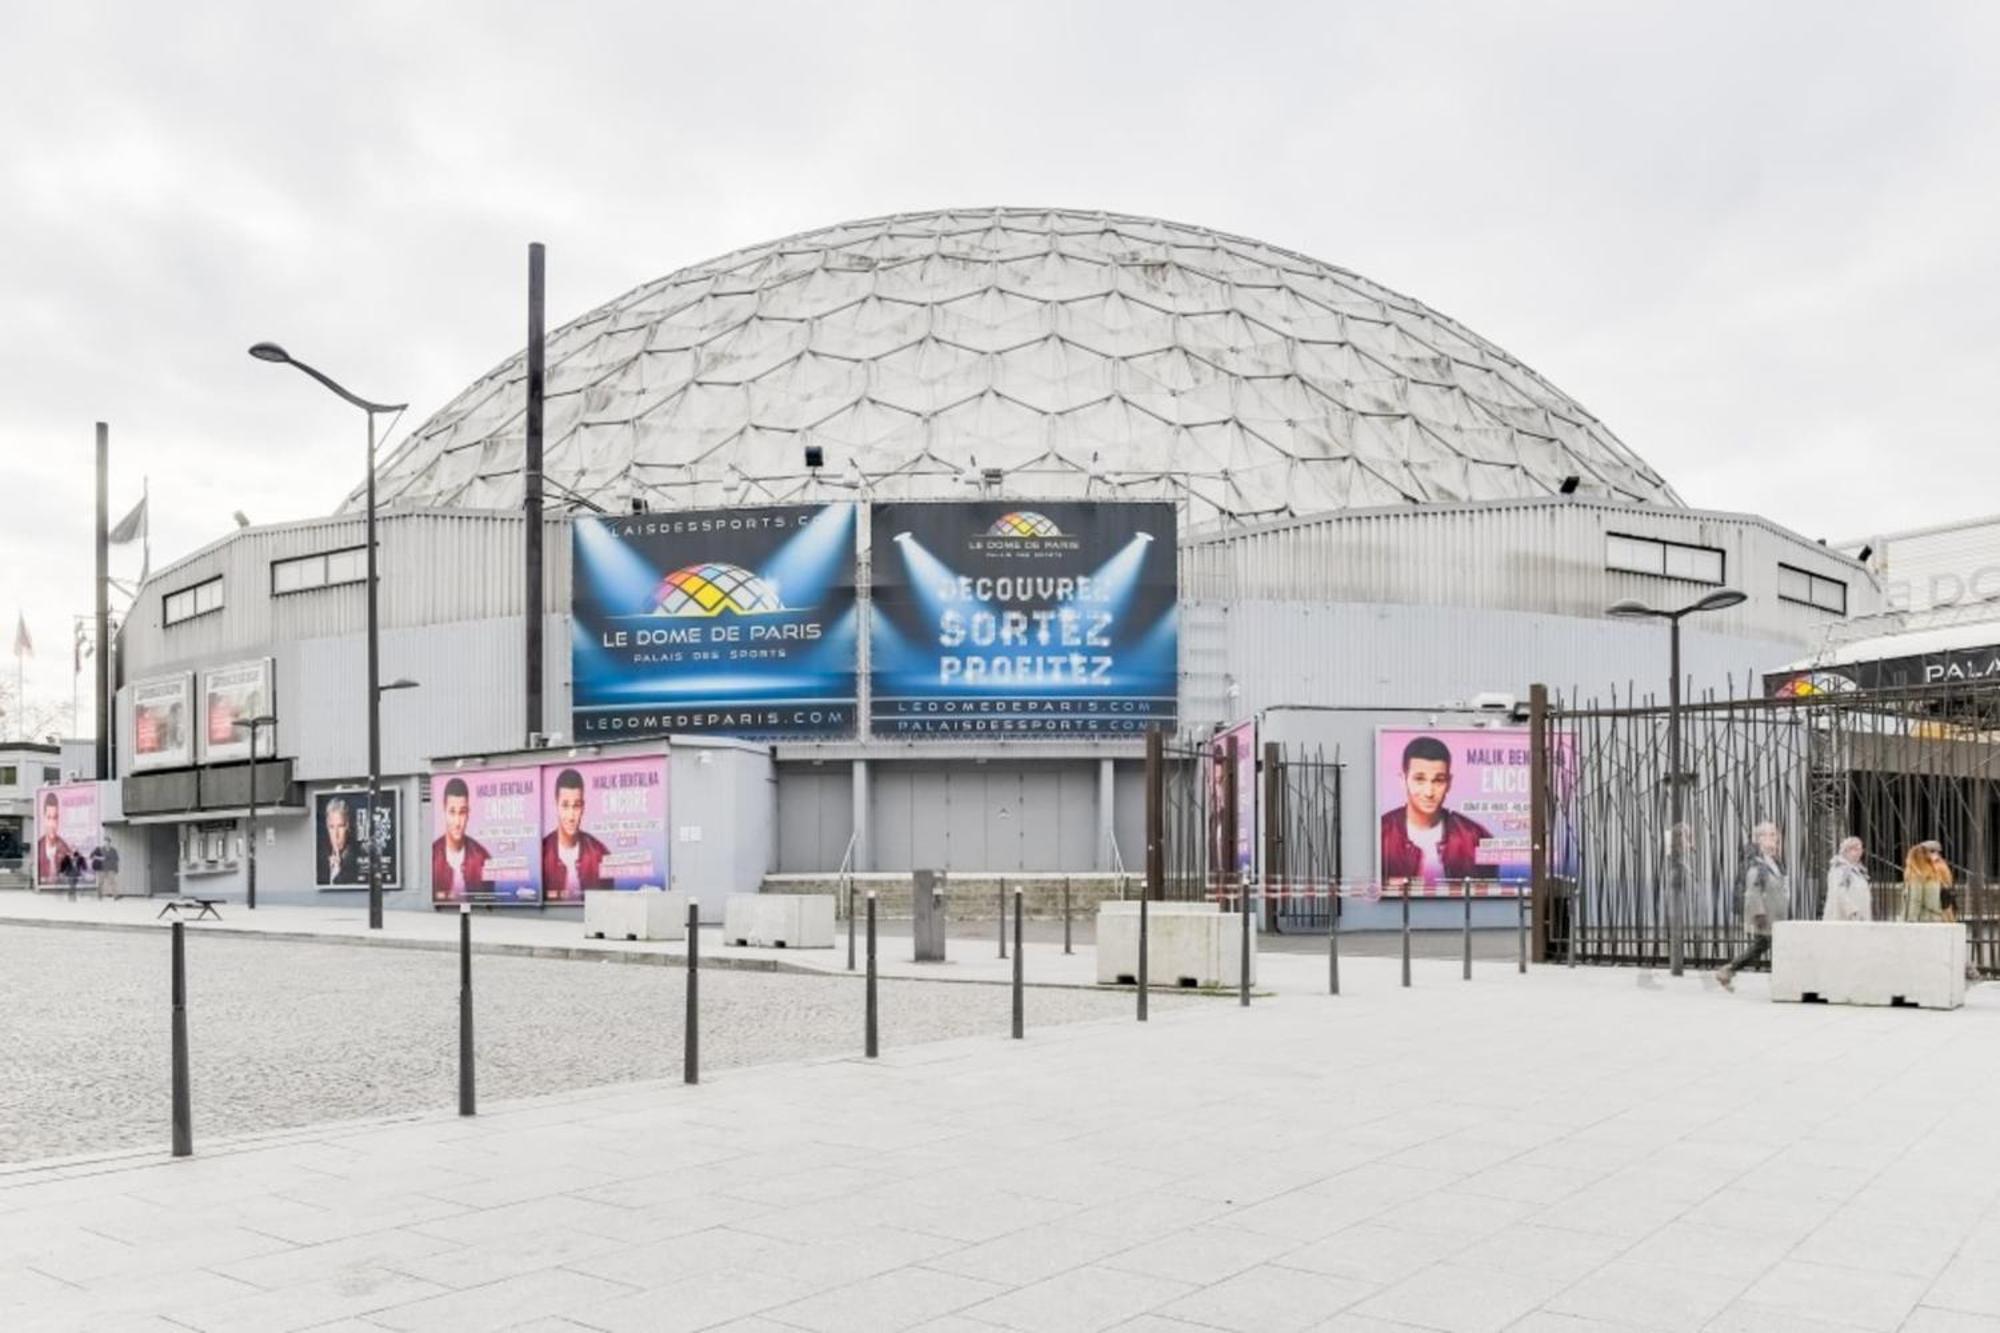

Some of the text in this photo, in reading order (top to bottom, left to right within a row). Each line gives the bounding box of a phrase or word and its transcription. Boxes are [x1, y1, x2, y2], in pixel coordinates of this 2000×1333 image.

[603, 624, 822, 647] LE DOME DE PARIS
[633, 649, 787, 662] PALAIS DES SPORTS
[898, 701, 1151, 713] LEDOMEDEPARIS.COM
[586, 711, 843, 730] LEDOMEDEPARIS.COM
[1466, 748, 1504, 766] MALIK
